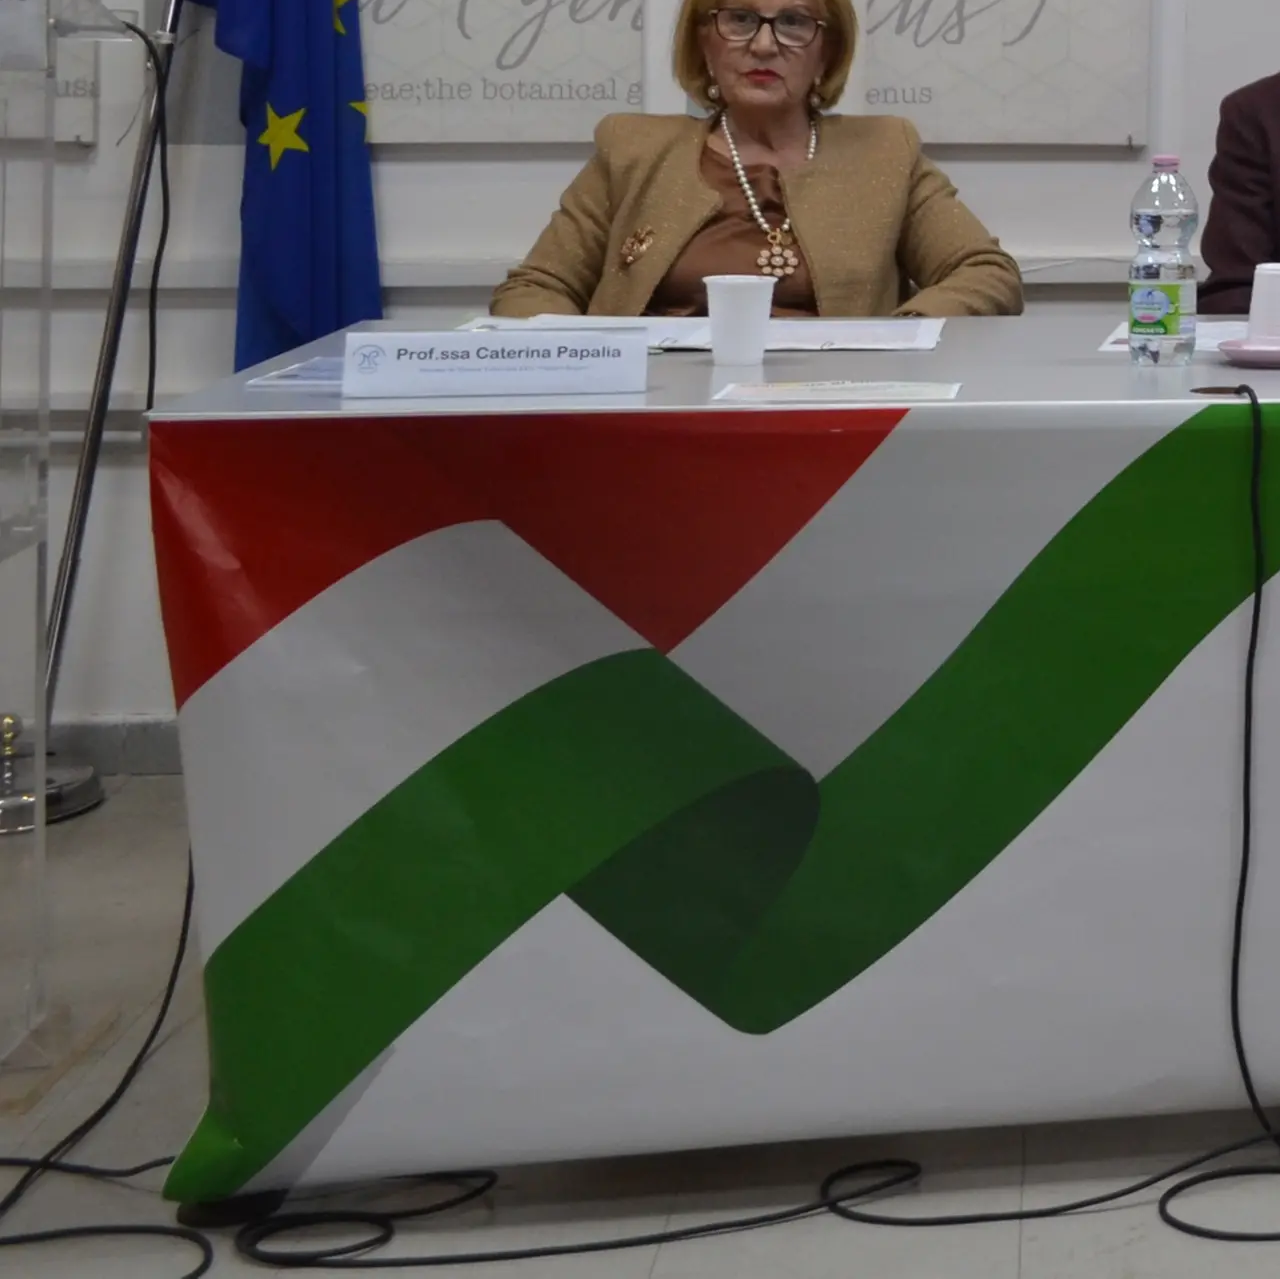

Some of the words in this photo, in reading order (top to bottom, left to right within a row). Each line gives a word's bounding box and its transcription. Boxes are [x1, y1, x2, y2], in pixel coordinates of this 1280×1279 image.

[482, 76, 618, 101] botanical
[396, 347, 471, 362] Prof.ssa
[475, 346, 552, 361] Caterina
[556, 345, 622, 361] Papalia
